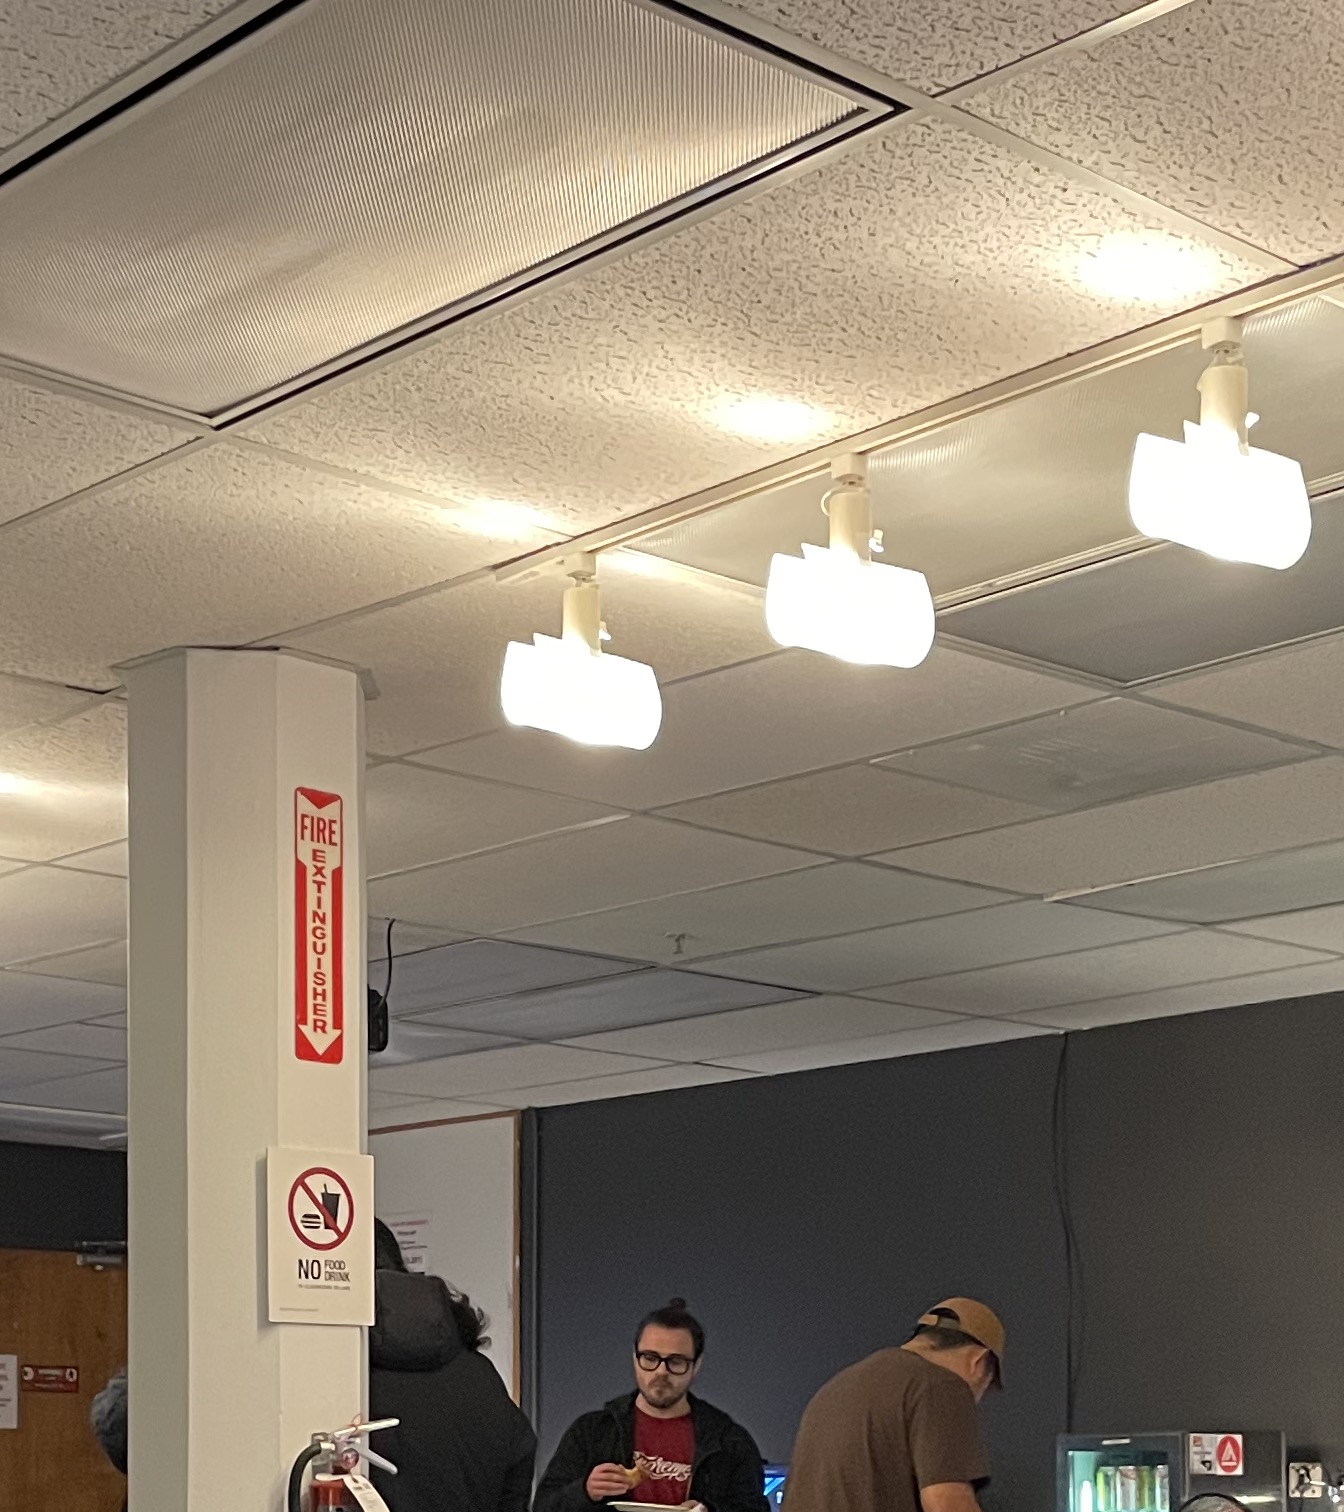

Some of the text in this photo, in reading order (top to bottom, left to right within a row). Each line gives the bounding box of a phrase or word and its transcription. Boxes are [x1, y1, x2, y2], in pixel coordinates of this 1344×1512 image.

[300, 813, 338, 846] FIRE
[311, 848, 327, 1035] EXTINGUISHER
[298, 1258, 346, 1280] NO FOOD
[324, 1271, 350, 1283] DRINK
